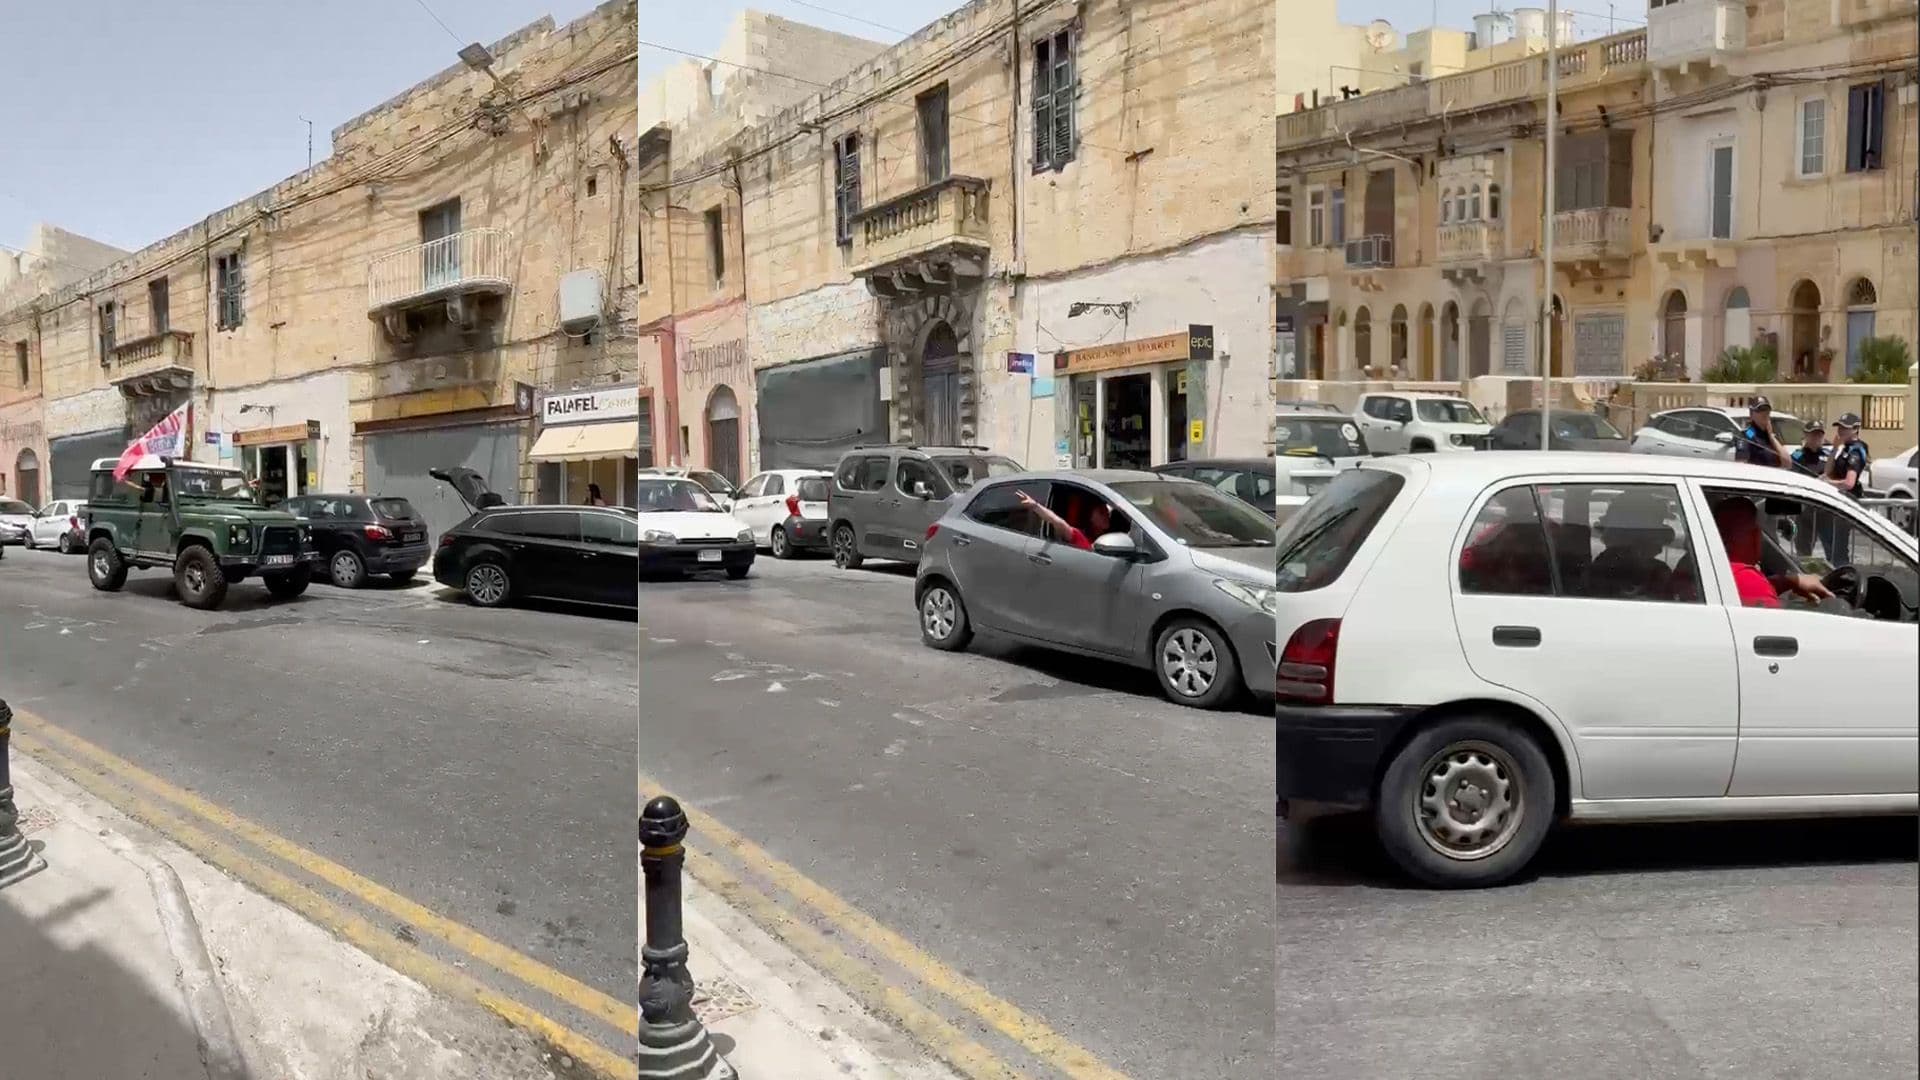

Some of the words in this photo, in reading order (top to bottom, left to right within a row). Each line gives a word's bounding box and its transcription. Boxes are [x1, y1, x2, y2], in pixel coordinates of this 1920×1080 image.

[1137, 339, 1177, 353] MARKET
[1191, 335, 1213, 350] epic
[547, 395, 599, 415] FALAFEL
